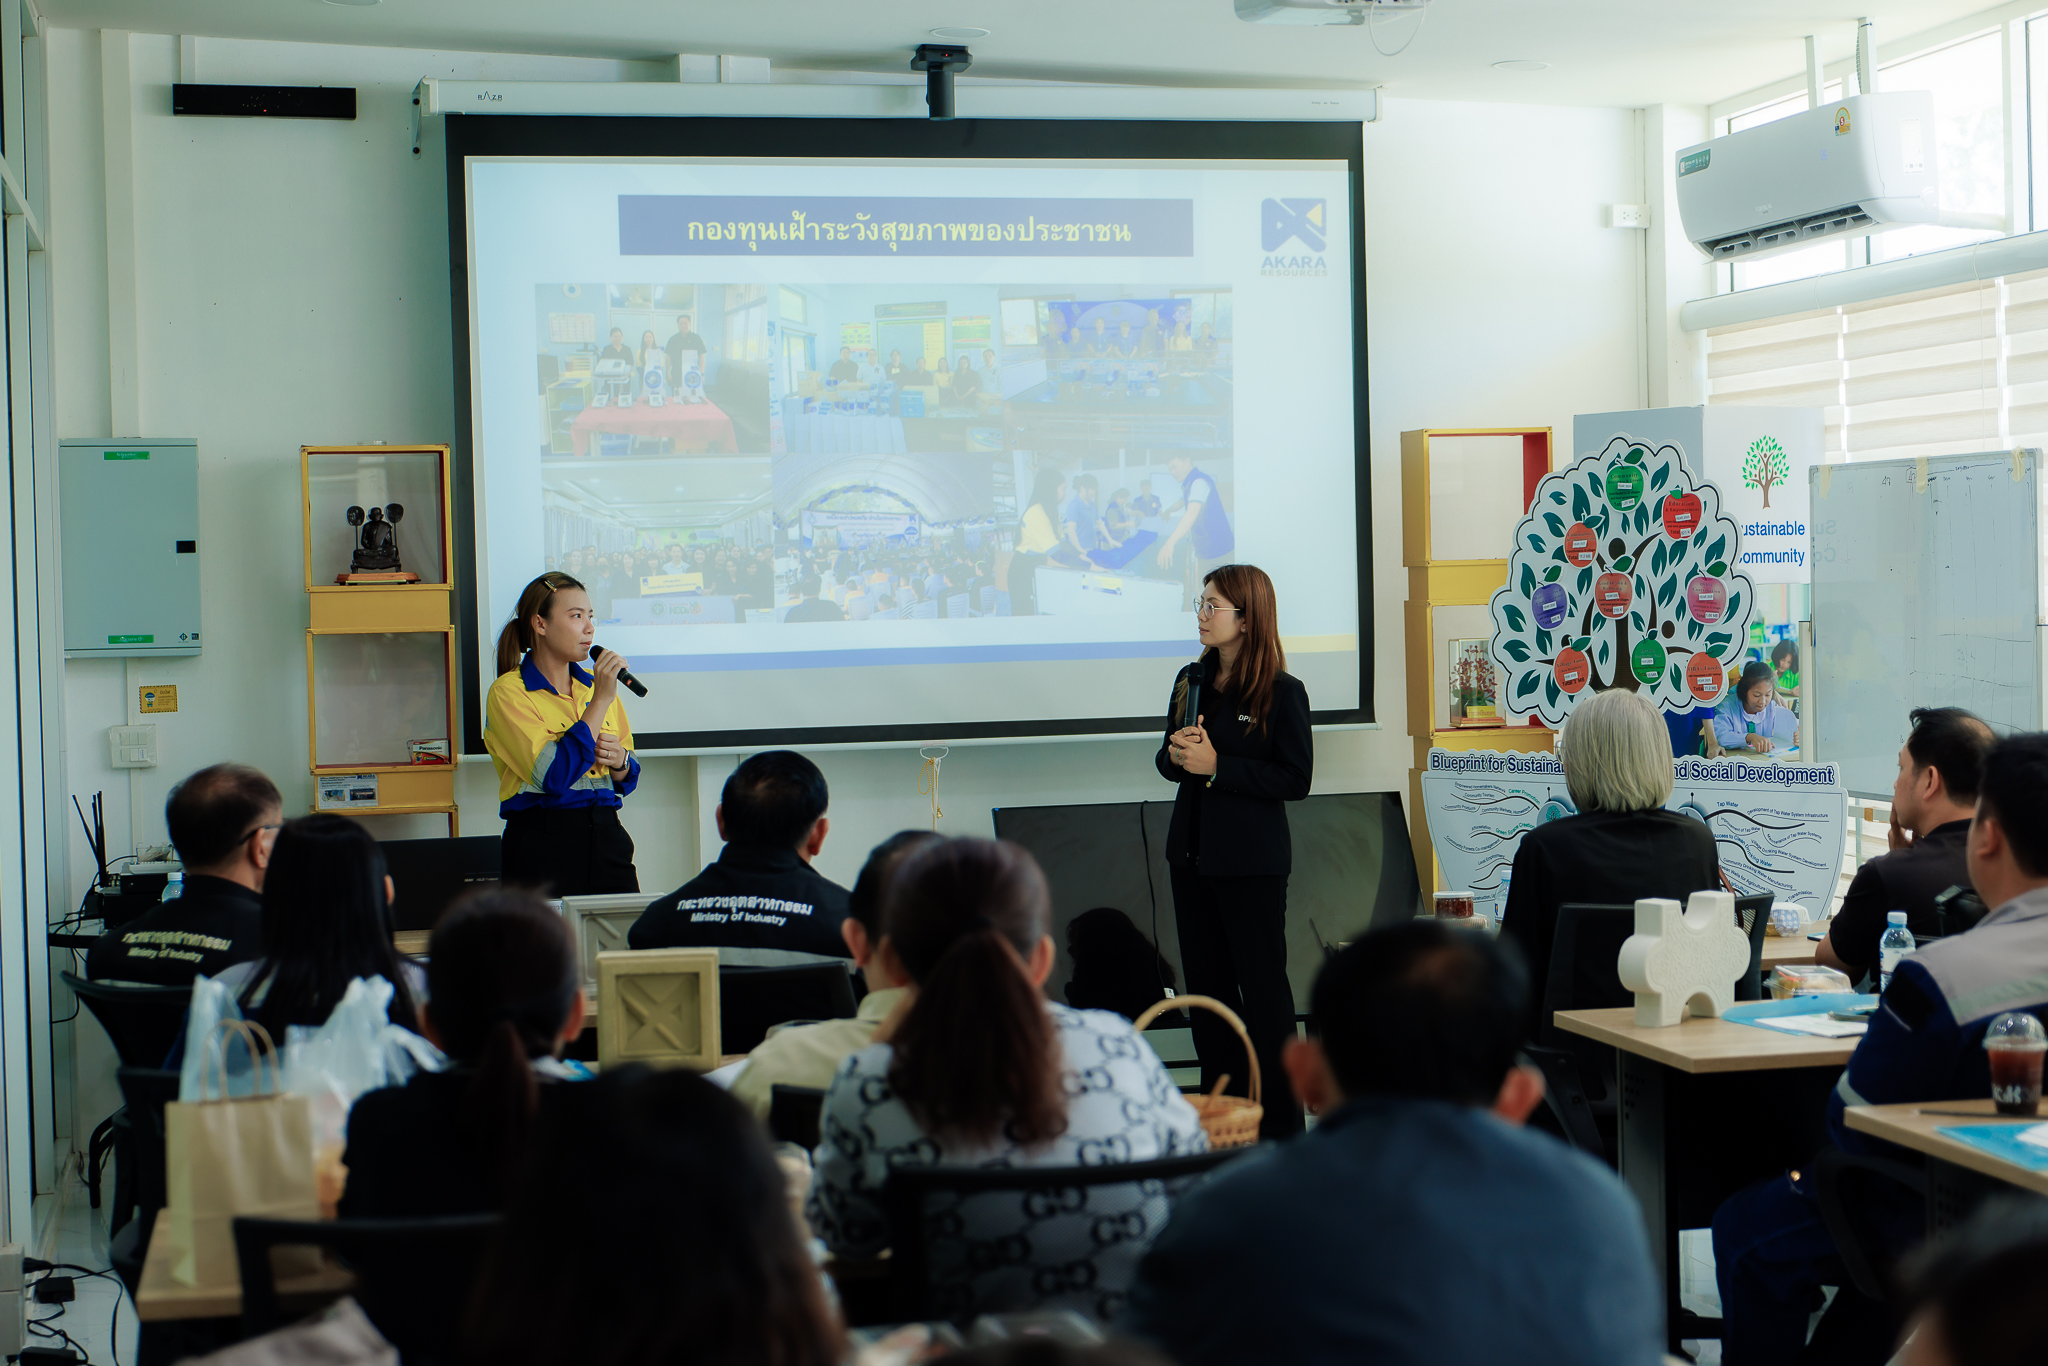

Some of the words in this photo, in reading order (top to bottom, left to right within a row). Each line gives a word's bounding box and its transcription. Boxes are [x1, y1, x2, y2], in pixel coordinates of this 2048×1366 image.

[687, 209, 1132, 253] กองทุนเฝ้าระวังสุขภาพของประชาชน
[1261, 256, 1327, 268] AKARA
[1260, 269, 1328, 277] RESOURCES
[1739, 548, 1806, 567] ommunity
[1432, 753, 1486, 774] Blueprint
[1488, 756, 1505, 771] for
[1691, 761, 1733, 781] Social
[1736, 763, 1834, 786] Development
[1521, 789, 1541, 805] Promotion
[1495, 828, 1507, 836] Green
[1734, 835, 1746, 845] Clean
[1759, 859, 1773, 867] Water
[1801, 858, 1827, 867] Development
[1722, 857, 1743, 868] Community
[1742, 863, 1757, 873] Drinking
[1767, 876, 1794, 890] Manufacturing
[1745, 879, 1766, 891] Agriculture
[676, 896, 813, 915] กระทรวงอุตสาหกรรม
[690, 911, 728, 924] Ministry
[730, 911, 744, 922] of
[744, 913, 787, 927] Industry
[127, 946, 157, 960] Ministry
[158, 948, 169, 958] of
[169, 949, 204, 963] Industry
